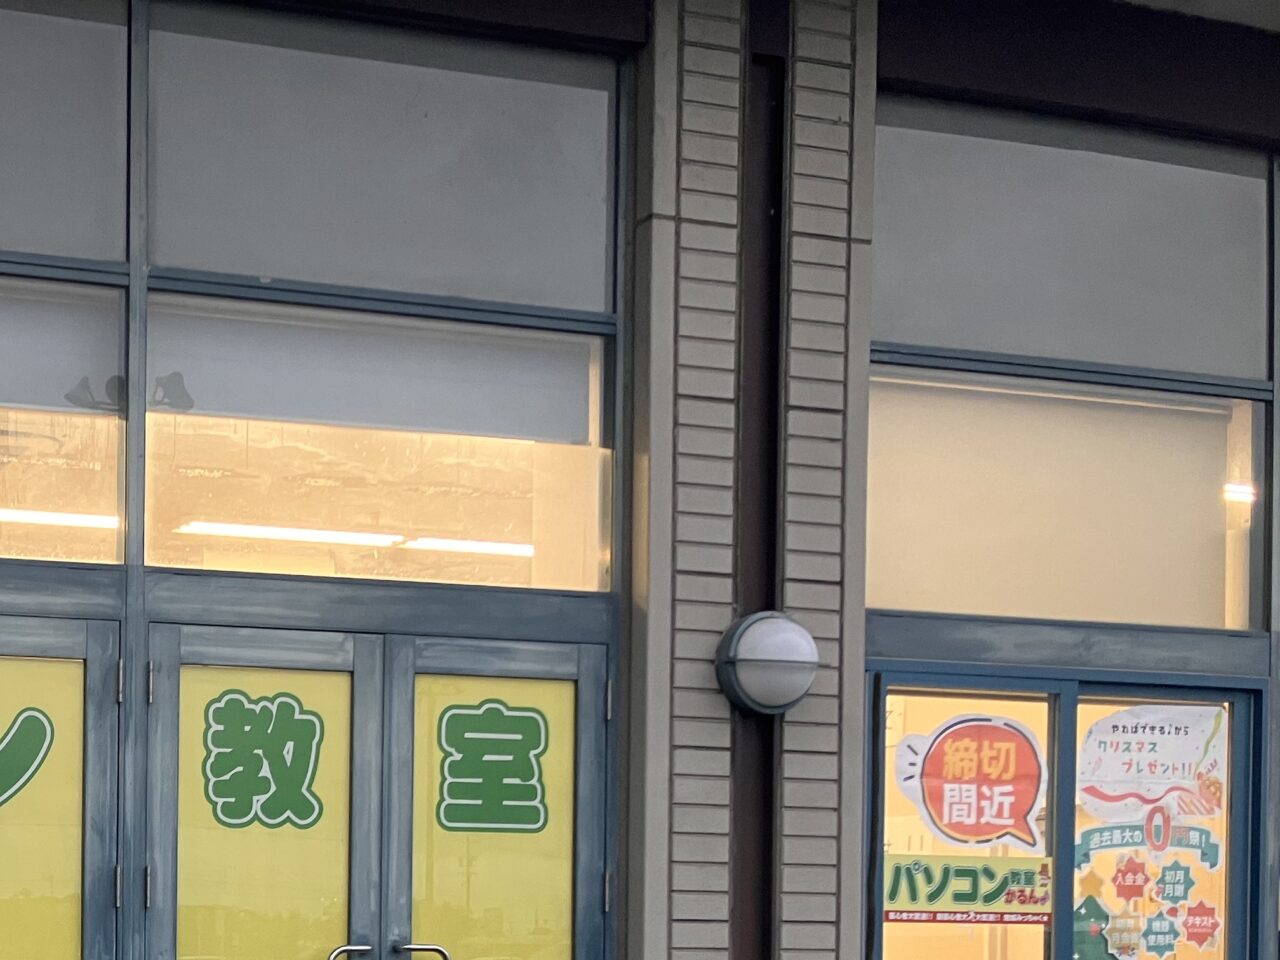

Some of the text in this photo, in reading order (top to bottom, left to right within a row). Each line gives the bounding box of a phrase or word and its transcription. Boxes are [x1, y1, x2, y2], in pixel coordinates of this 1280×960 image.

[1098, 740, 1158, 753] クリスマス
[943, 739, 1016, 781] 締切
[942, 783, 1015, 825] 間近
[1115, 873, 1146, 886] 入会金
[1186, 916, 1216, 928] テキスト
